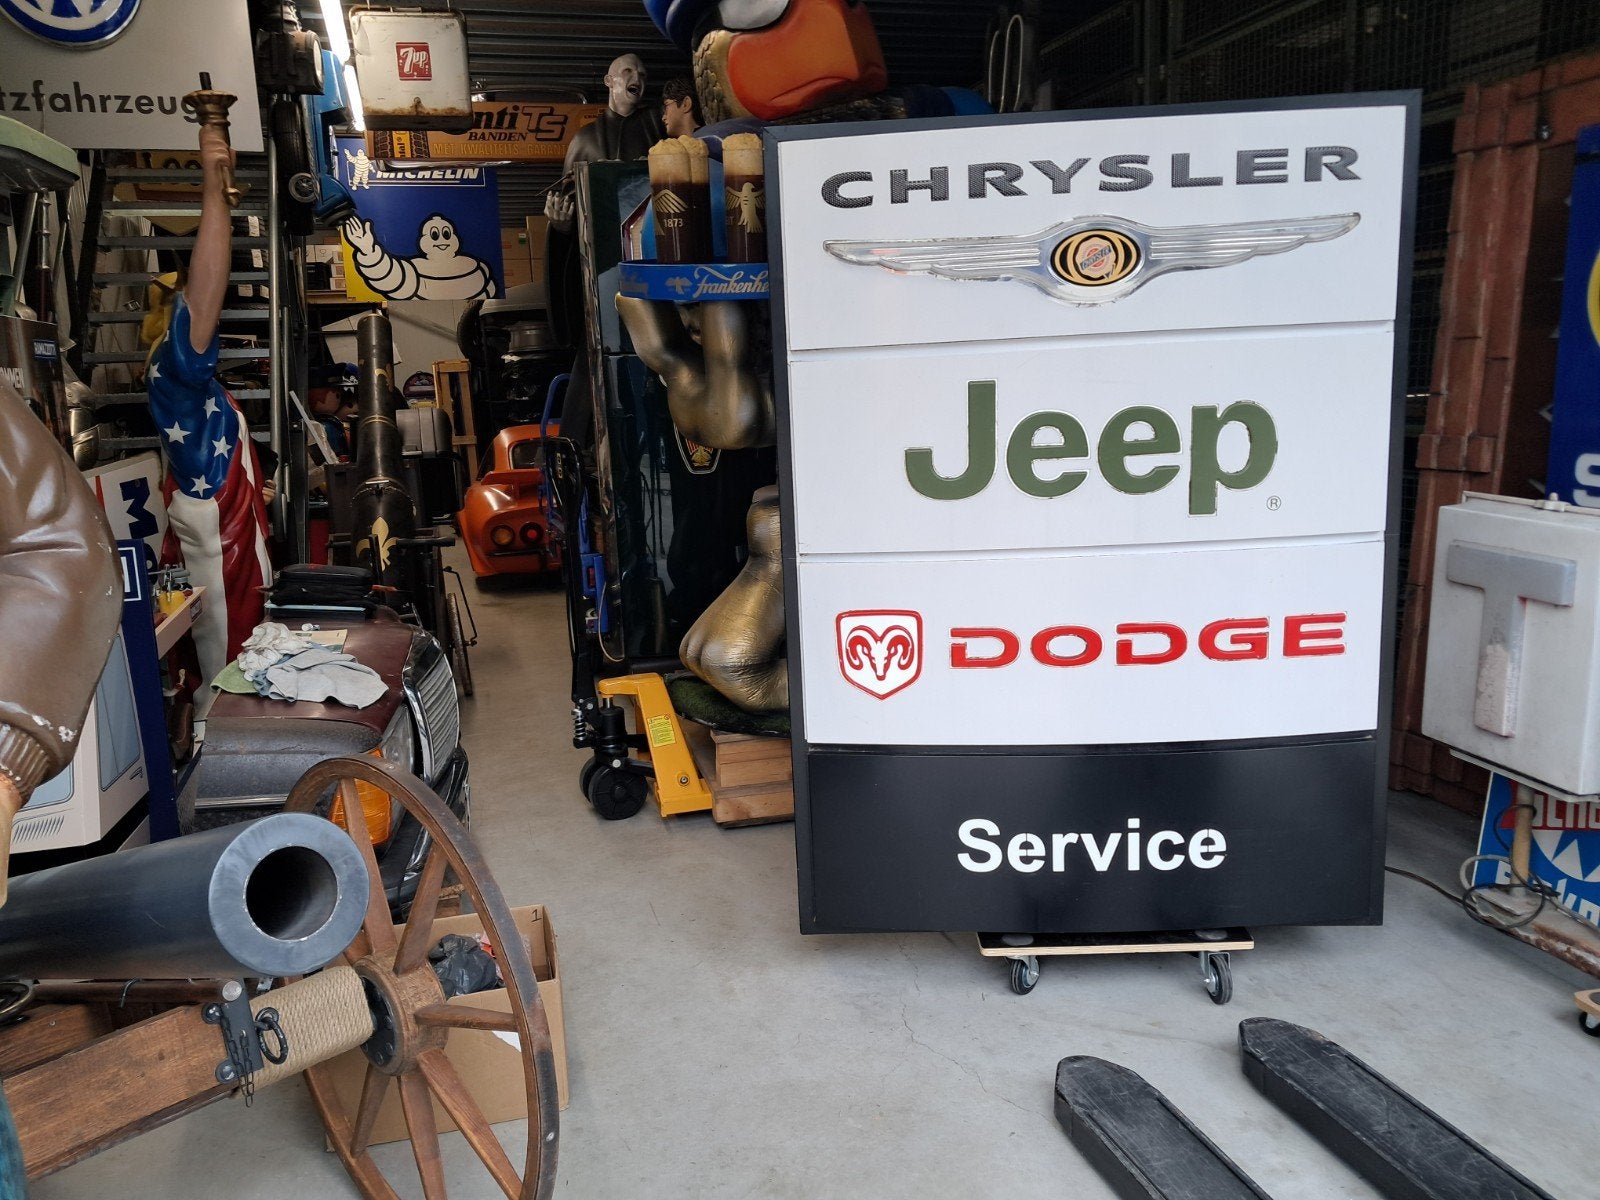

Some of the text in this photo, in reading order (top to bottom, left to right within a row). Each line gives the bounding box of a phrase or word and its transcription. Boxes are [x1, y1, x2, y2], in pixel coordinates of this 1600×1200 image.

[432, 143, 455, 155] MET
[461, 143, 519, 155] KWALITEITS
[467, 131, 529, 141] BANDEN
[522, 106, 568, 141] TS
[821, 147, 1362, 209] CHRYSLER
[664, 218, 684, 228] 1873
[904, 379, 1279, 518] Jeep
[948, 610, 1348, 669] DODGE
[1447, 540, 1578, 738] T
[957, 817, 1228, 873] Service
